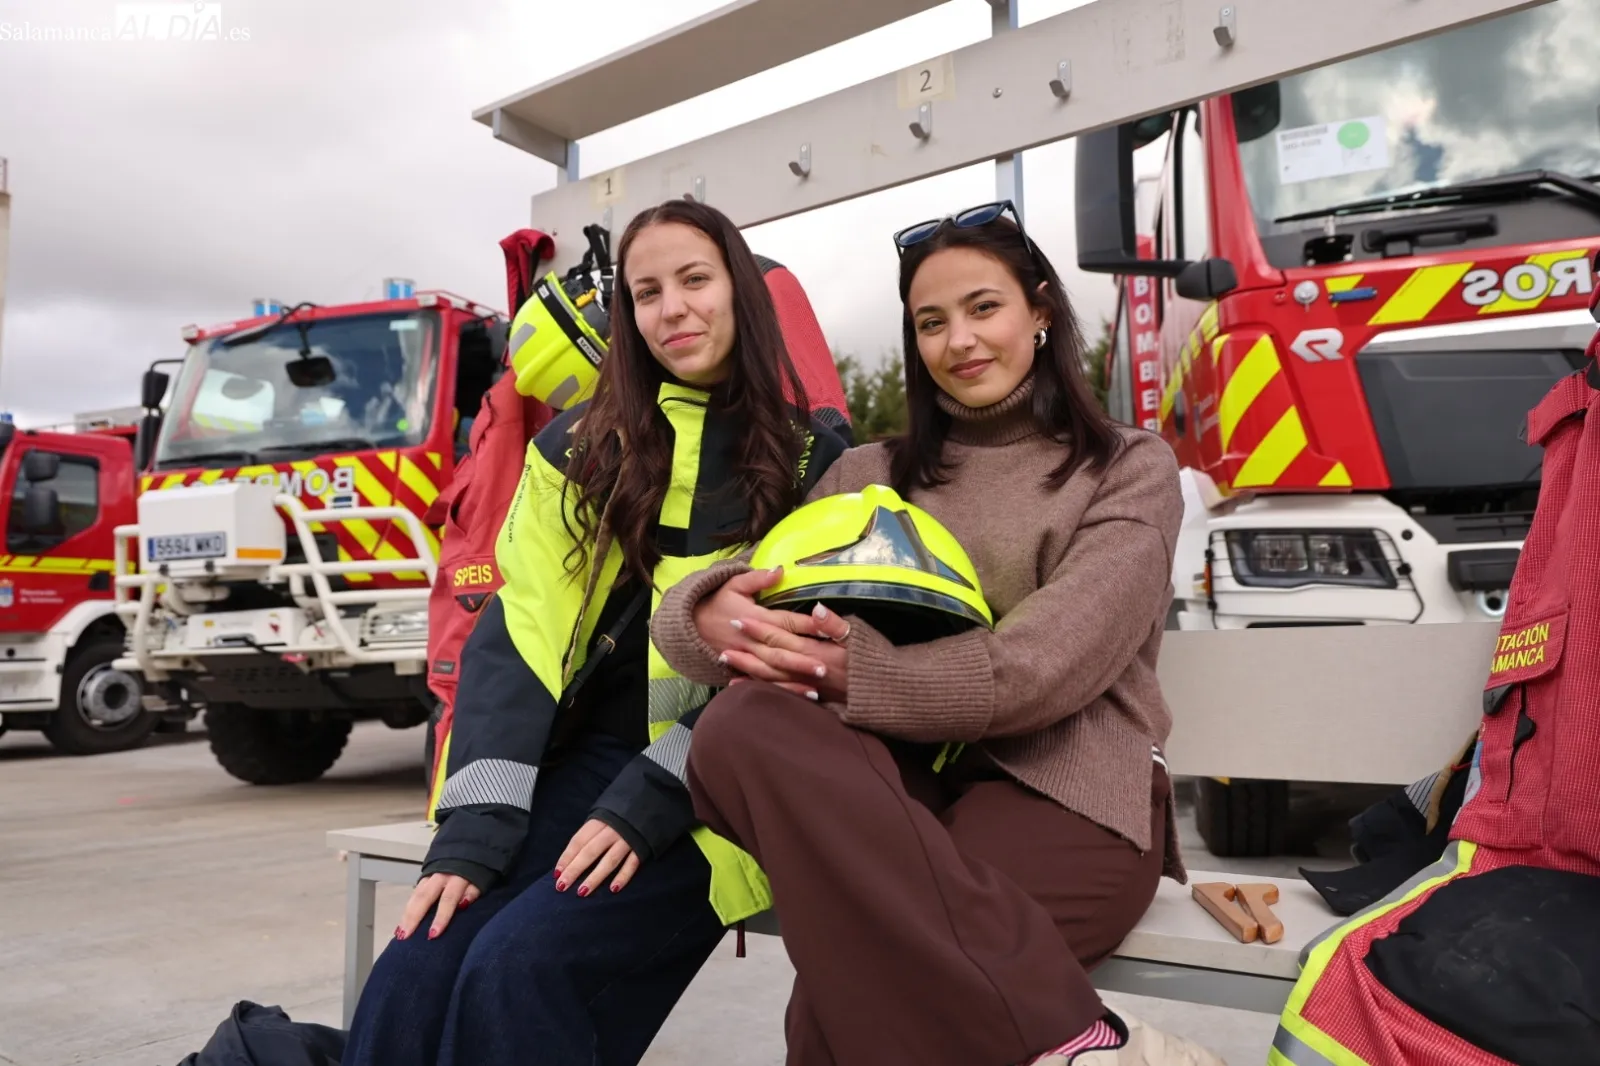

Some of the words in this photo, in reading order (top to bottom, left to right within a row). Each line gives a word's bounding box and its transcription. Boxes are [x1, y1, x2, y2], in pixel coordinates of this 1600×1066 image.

[920, 69, 932, 92] 2
[605, 177, 612, 196] 1
[453, 564, 493, 587] SPEIS
